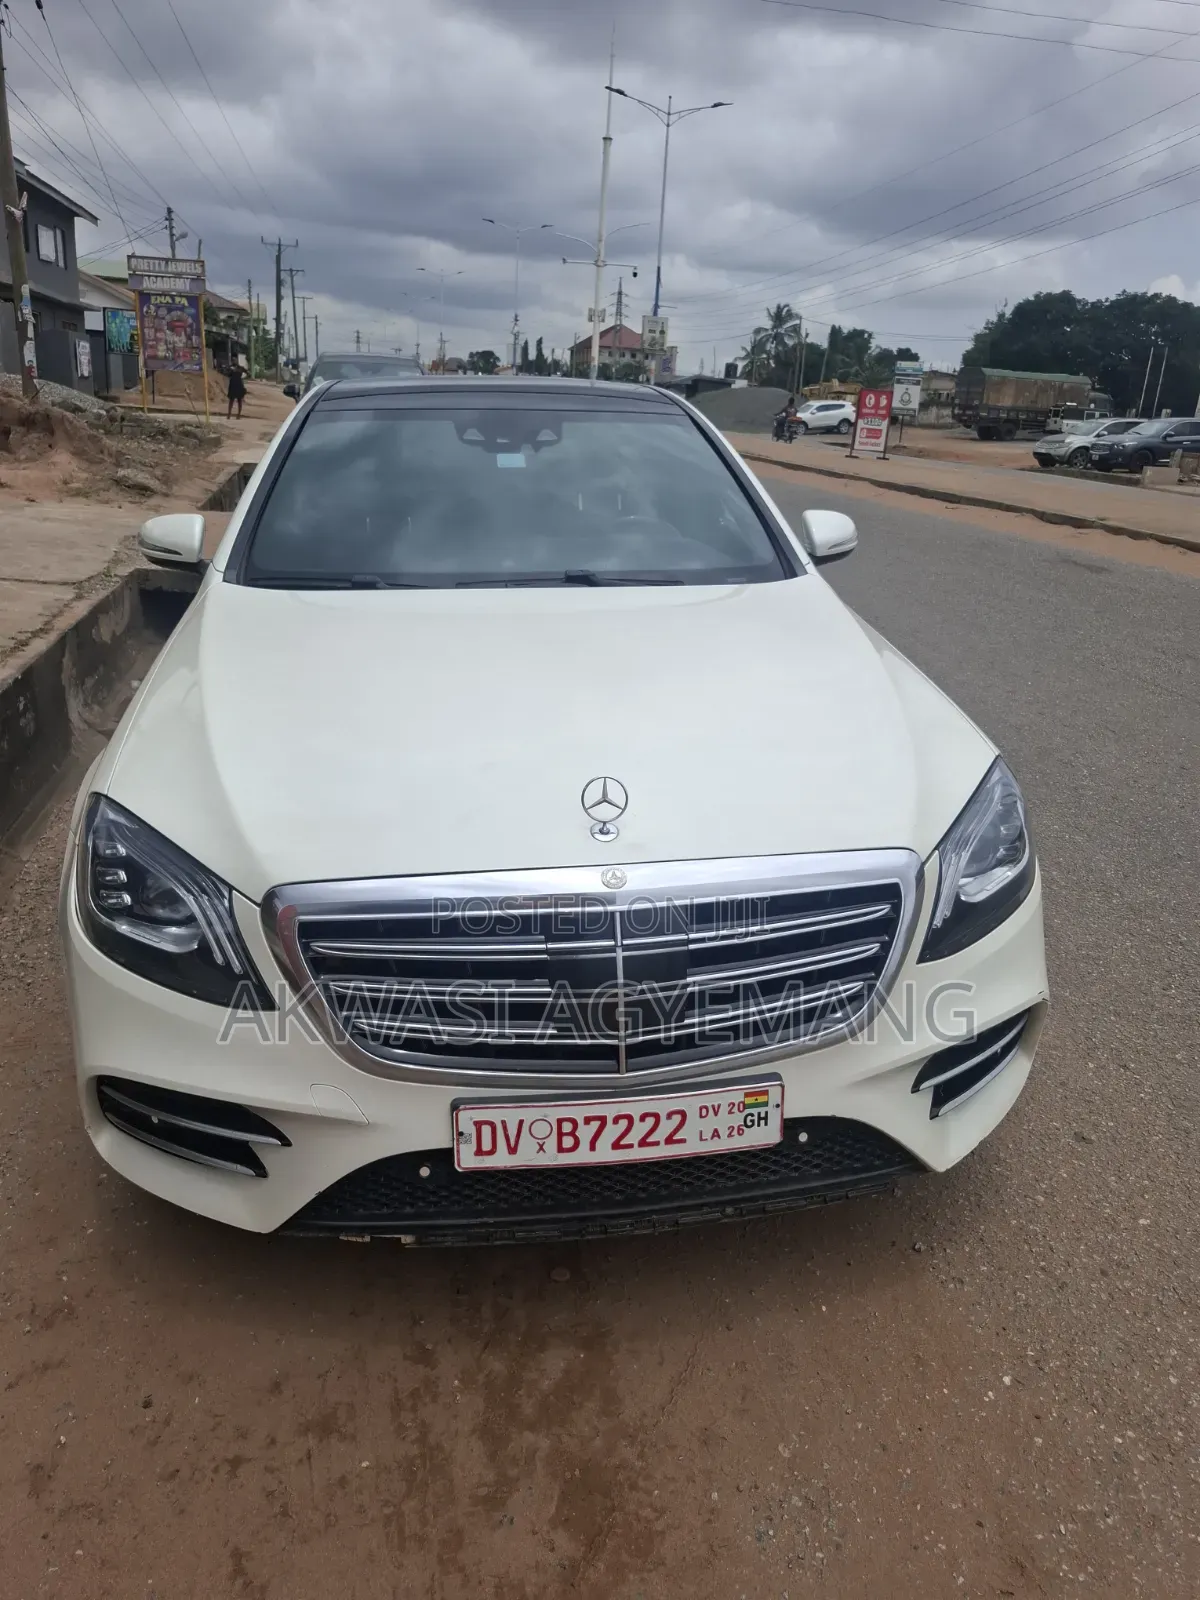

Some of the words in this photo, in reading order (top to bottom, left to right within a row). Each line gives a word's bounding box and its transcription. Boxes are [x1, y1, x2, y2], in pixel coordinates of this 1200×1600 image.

[131, 258, 166, 271] PRETTY
[167, 260, 202, 273] JEWELS
[143, 276, 190, 290] ACADEMY
[698, 1103, 721, 1118] DV
[727, 1100, 745, 1115] 20
[743, 1111, 769, 1129] GH
[473, 1119, 524, 1156] DV
[556, 1109, 688, 1153] B7222
[698, 1129, 721, 1142] LA
[727, 1124, 745, 1137] 26
